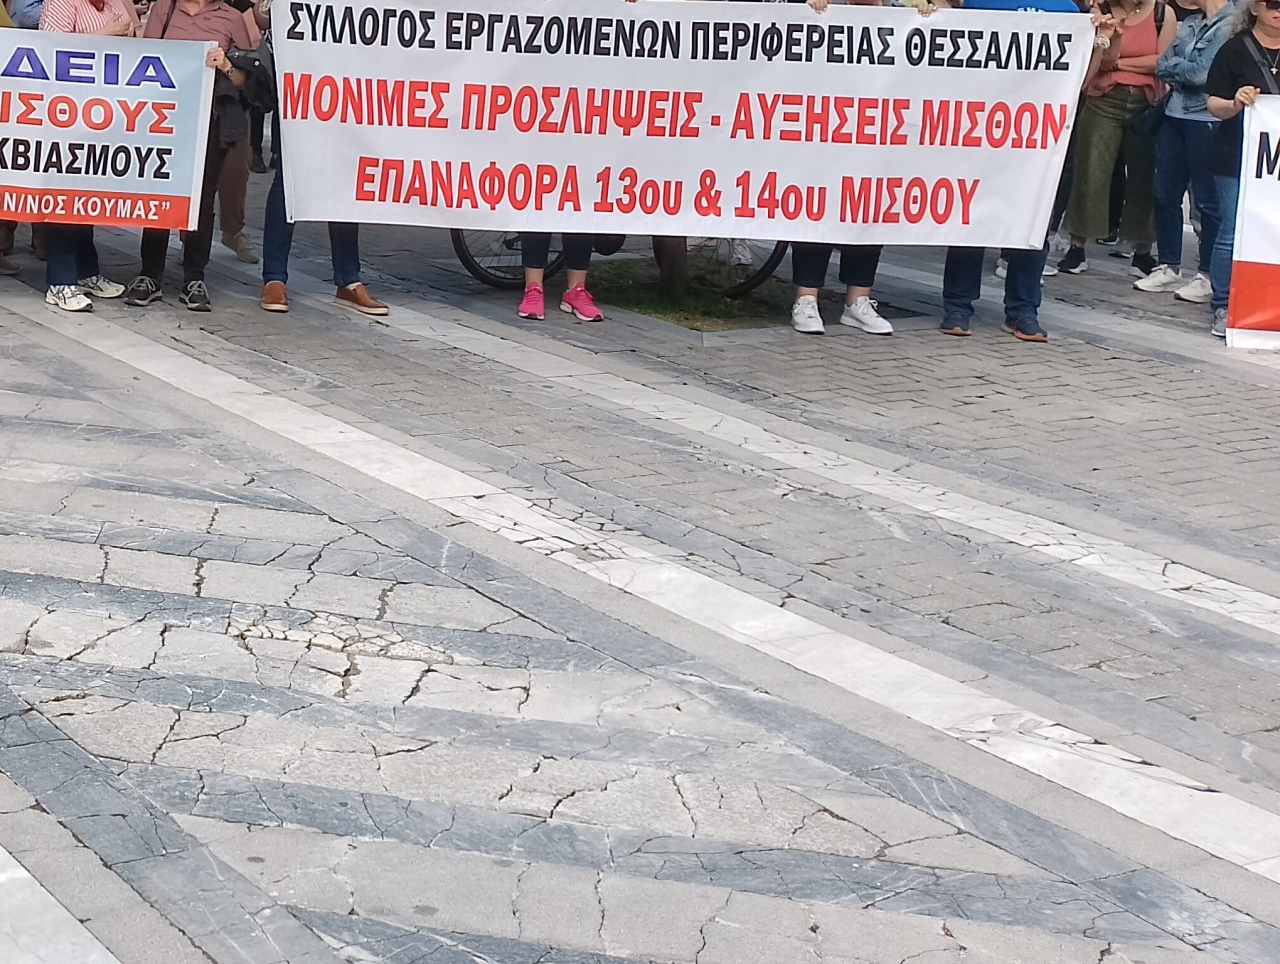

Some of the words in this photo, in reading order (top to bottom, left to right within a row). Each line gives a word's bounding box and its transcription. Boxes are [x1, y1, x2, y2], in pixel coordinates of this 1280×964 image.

[286, 2, 435, 49] ΣΥΛΛΟΓΟΣ
[445, 12, 681, 59] ΕΡΓΑΖΟΜΕΝΩΝ
[691, 21, 895, 66] ΠΕΡΙΦΕΡΕΙΑΣ
[905, 28, 1072, 71] ΘΕΣΣΑΛΙΑΣ
[283, 72, 450, 129] ΜΟΝΙΜΕΣ
[461, 84, 703, 138] ΠΡΟΣΛΗΨΕΙΣ
[730, 93, 910, 146] ΑΥΞΗΣΕΙΣ
[919, 99, 1068, 149] ΜΙΣΘΩΝ
[355, 156, 581, 213] ΕΠΑΝΑΦΟΡΑ
[594, 166, 683, 215] 13ου
[694, 169, 722, 218] &
[734, 170, 827, 221] 14ου
[840, 176, 980, 225] ΜΙΣΘΟΥ
